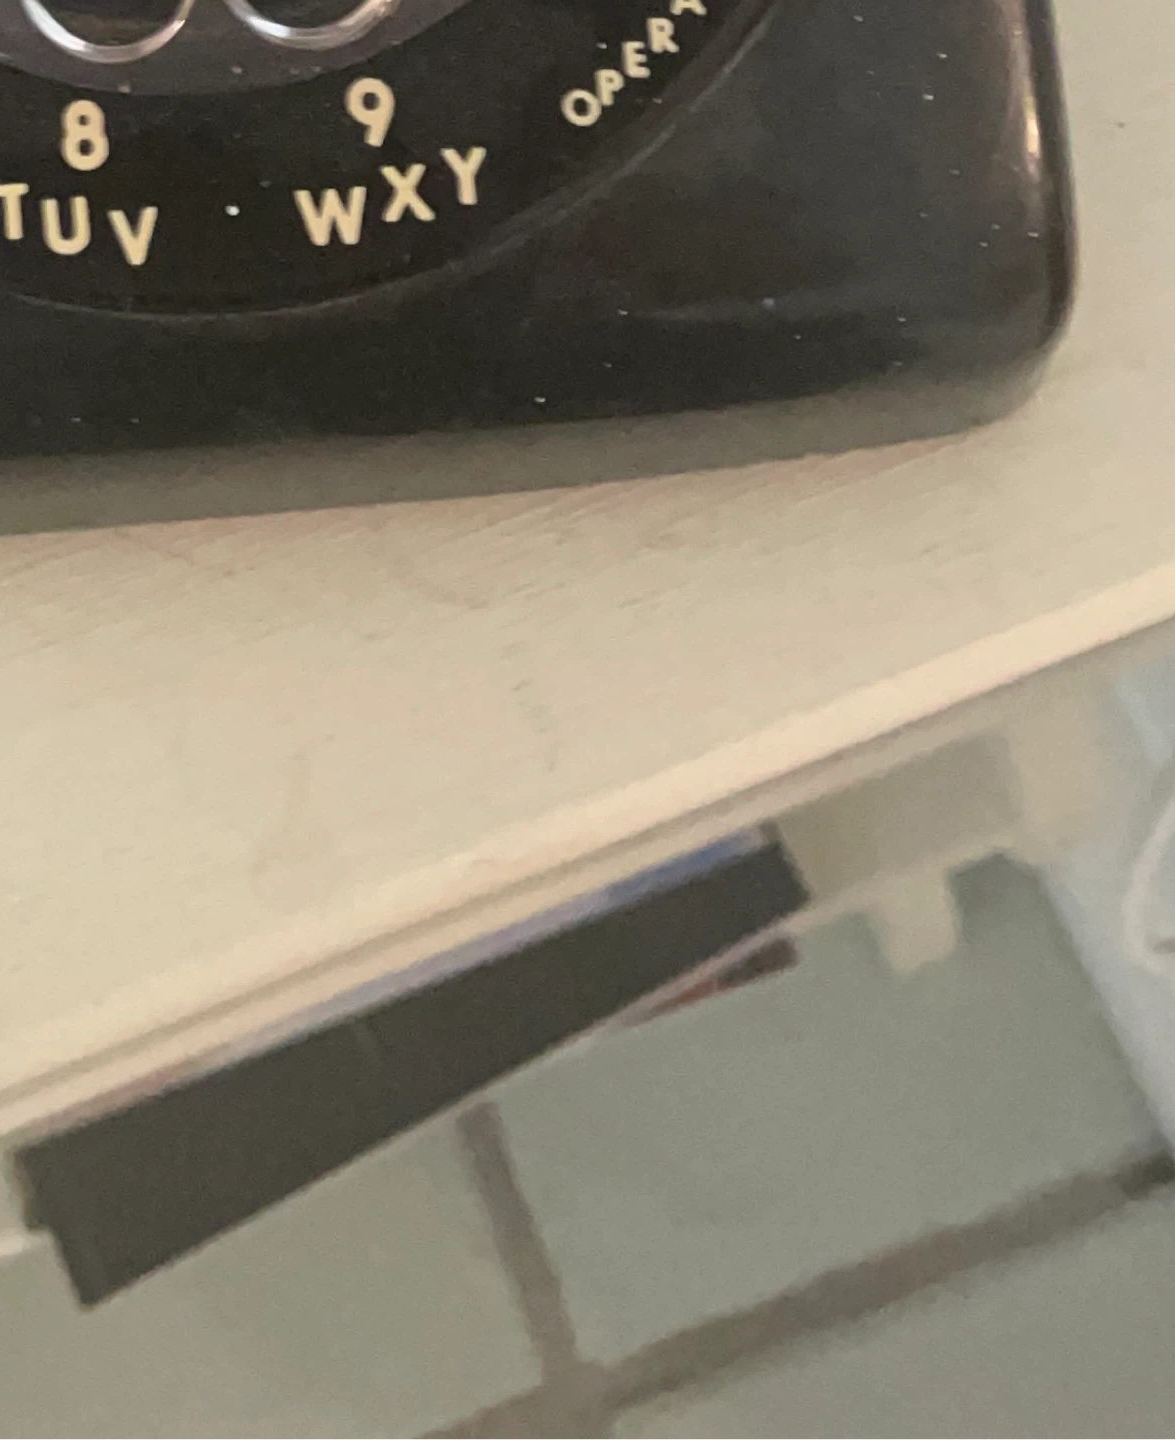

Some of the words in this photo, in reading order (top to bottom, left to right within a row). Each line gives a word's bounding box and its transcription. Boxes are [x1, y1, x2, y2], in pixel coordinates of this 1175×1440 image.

[60, 98, 111, 173] 8
[345, 76, 396, 148] 9
[293, 146, 488, 248] WXY
